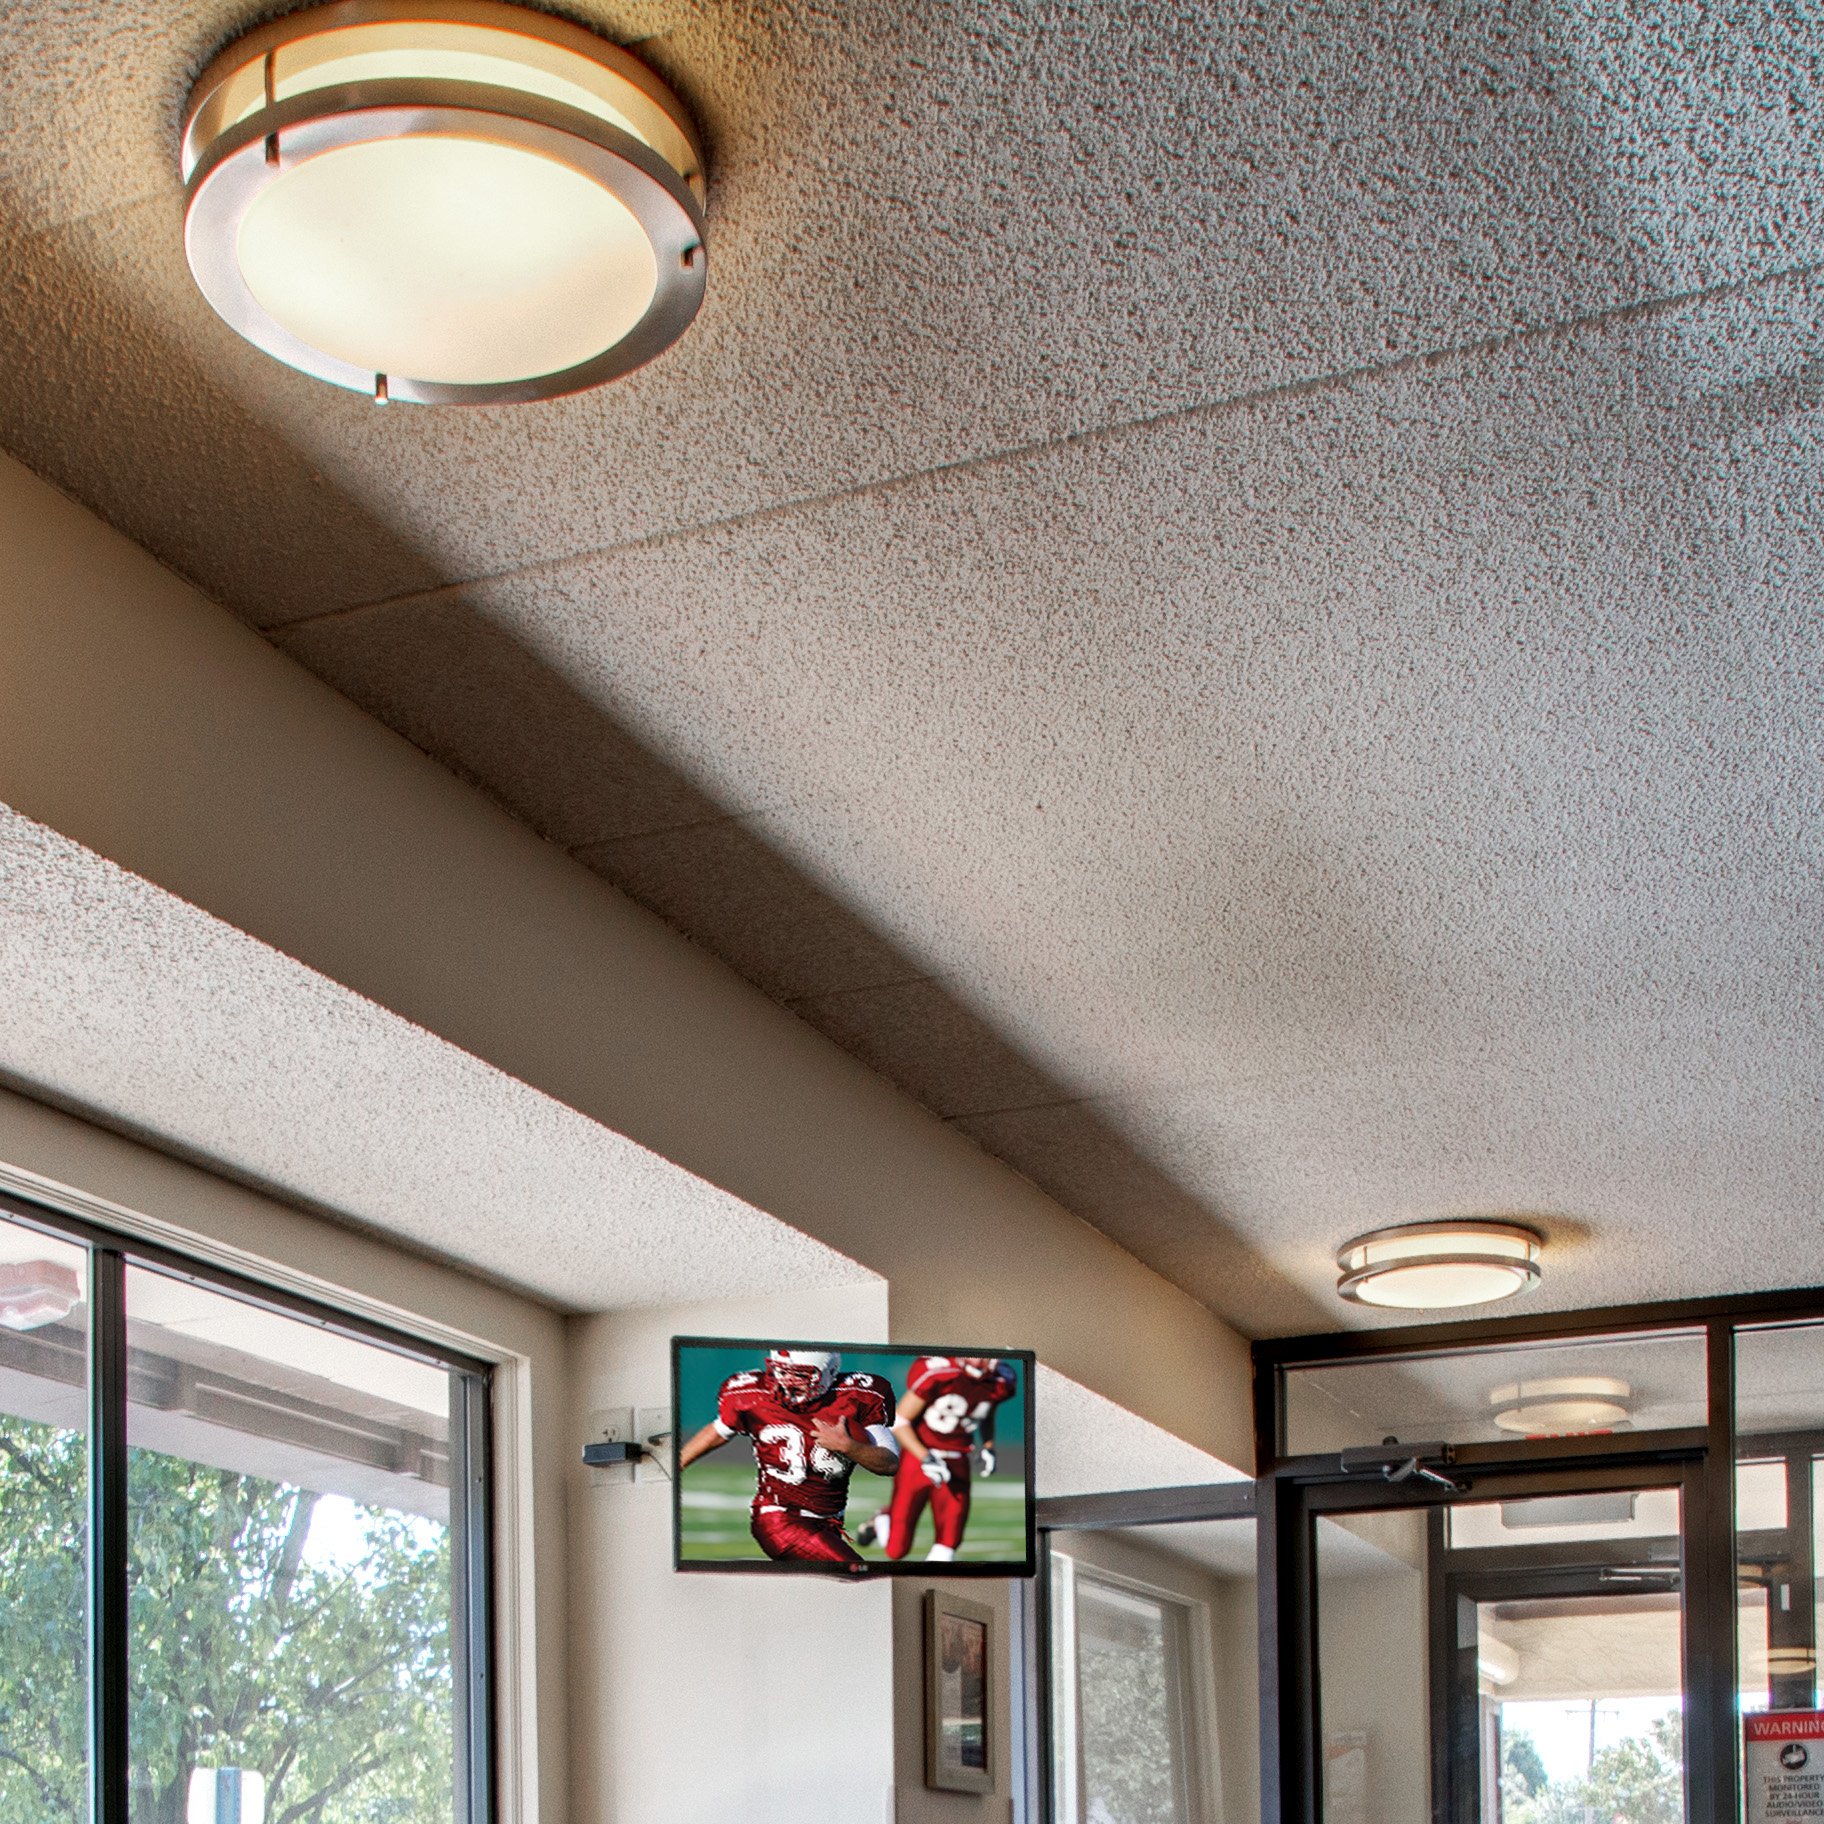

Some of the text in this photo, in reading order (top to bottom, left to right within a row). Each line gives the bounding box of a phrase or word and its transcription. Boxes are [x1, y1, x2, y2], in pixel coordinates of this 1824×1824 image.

[1783, 1774, 1824, 1783] PROPERTY
[1768, 1783, 1820, 1791] MONITORED
[1766, 1800, 1824, 1809] AUDIO/VIDEO
[1764, 1808, 1824, 1817] SURVEILLANCE
